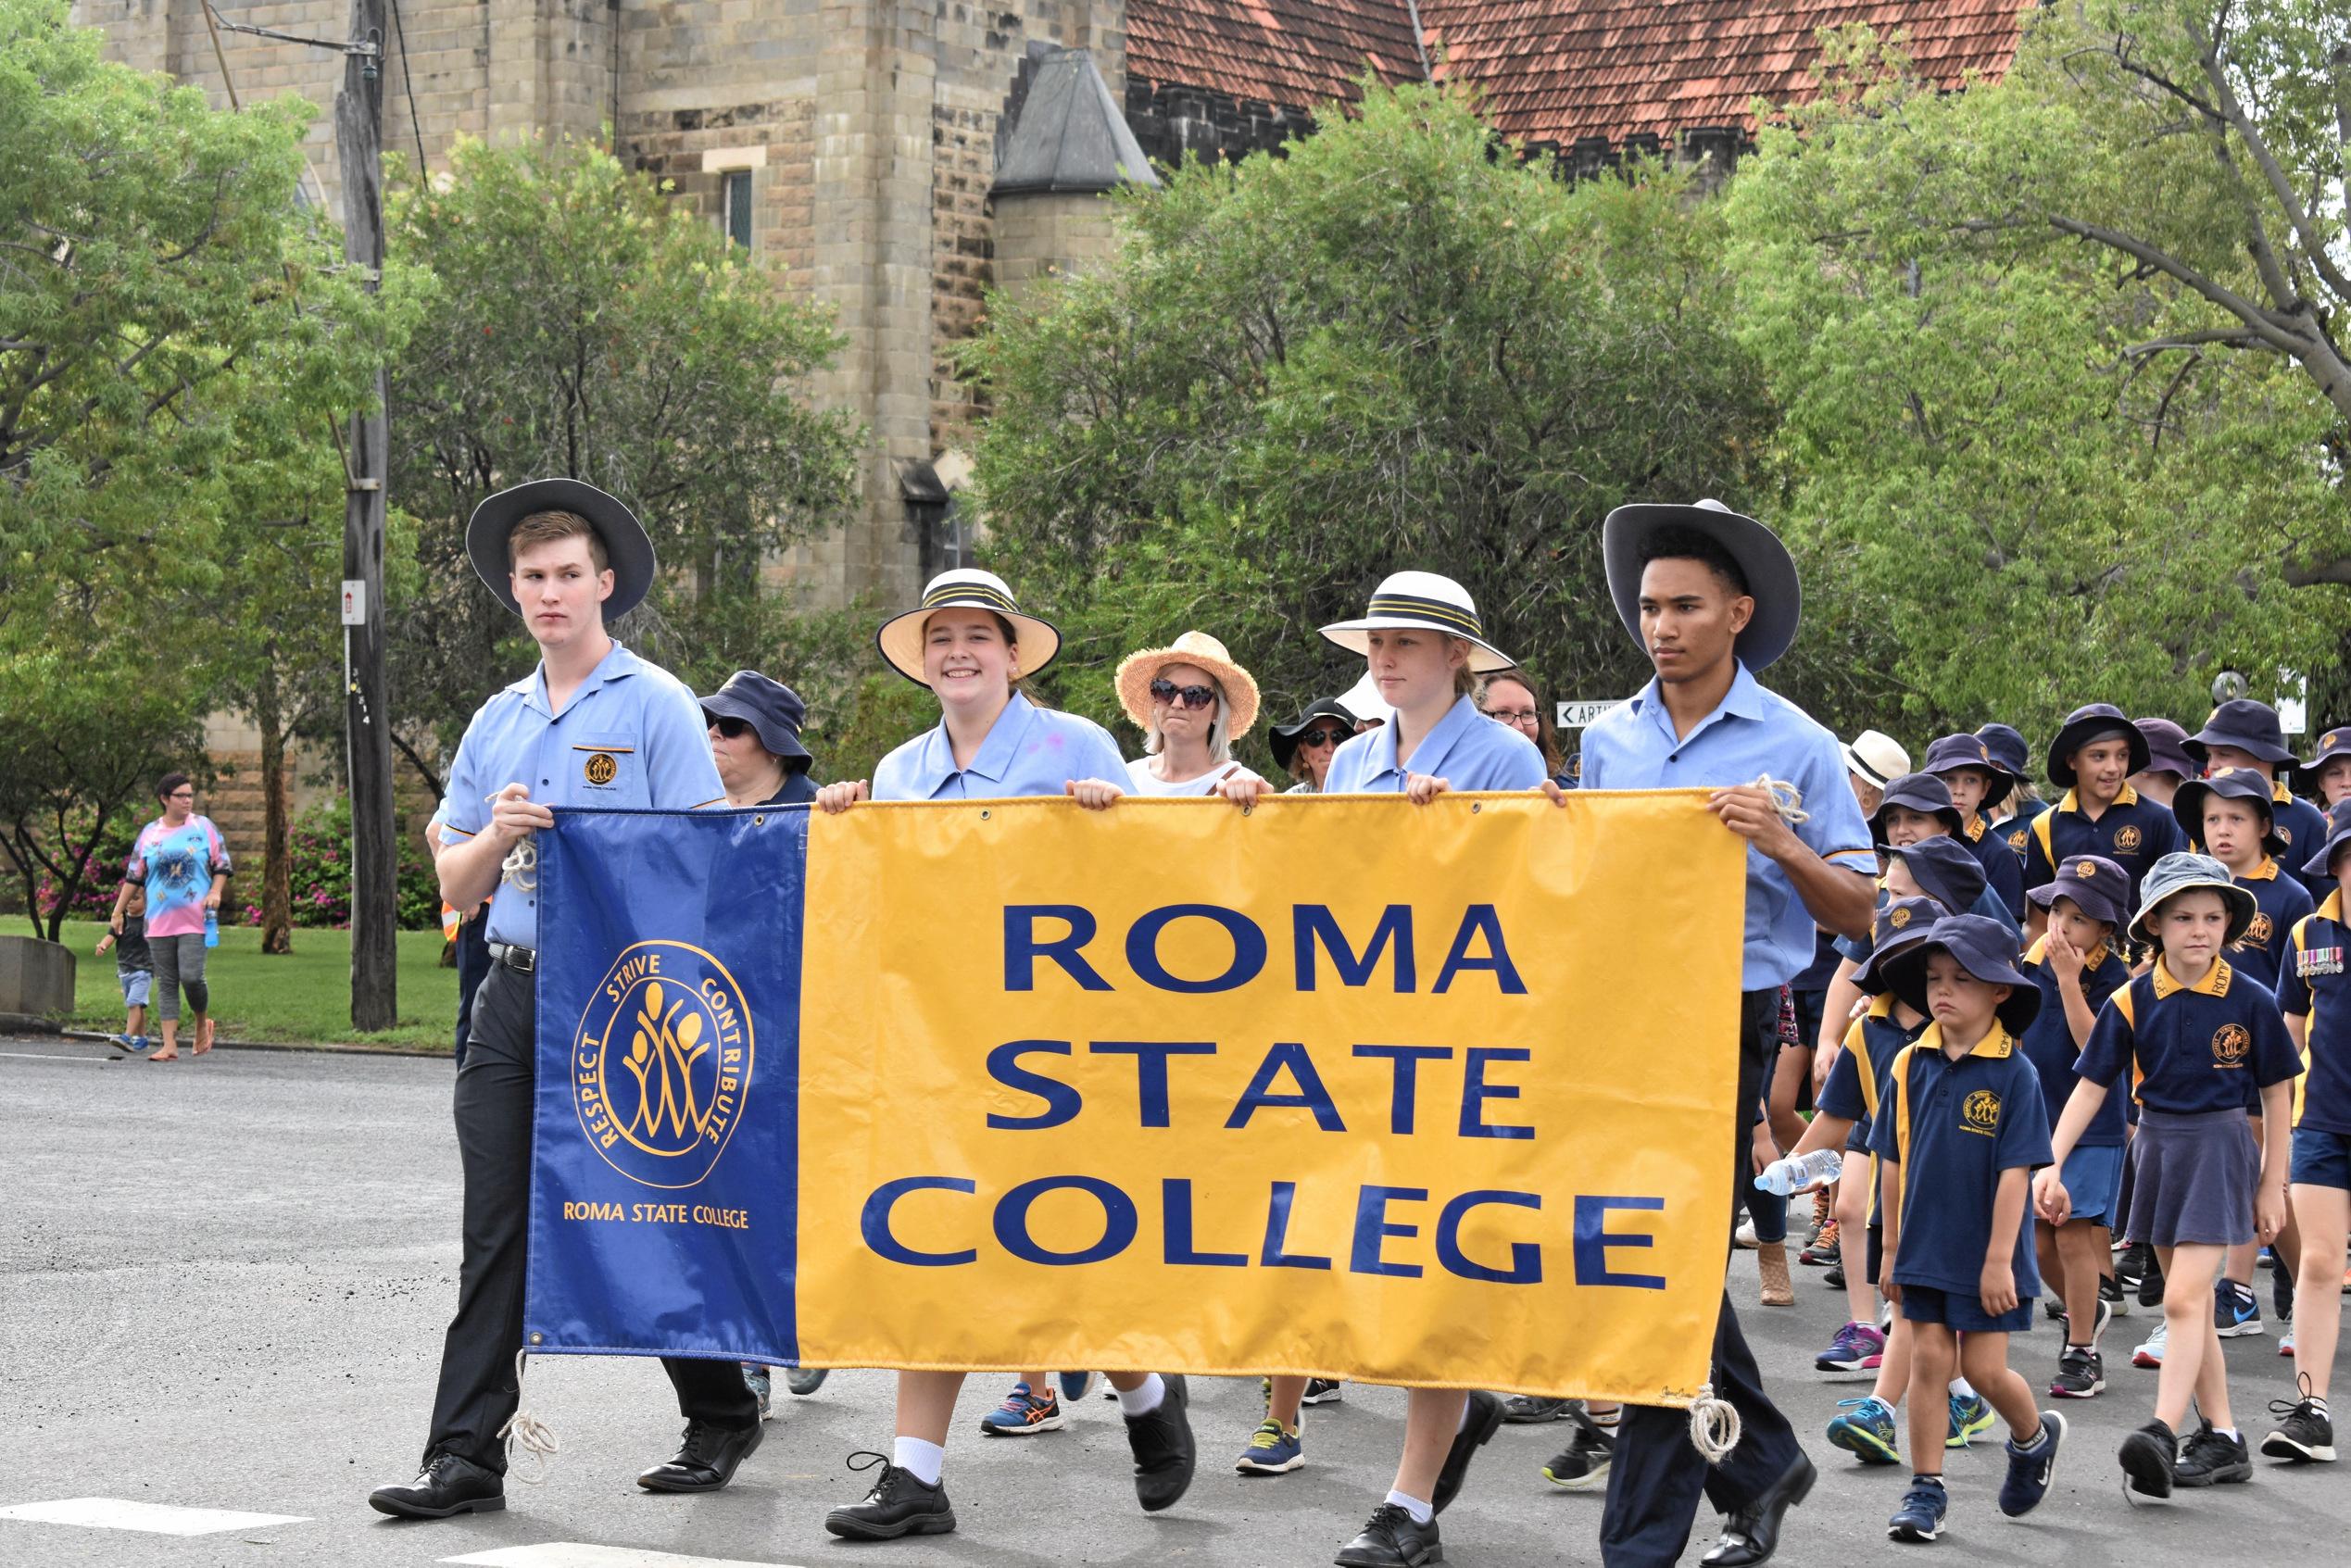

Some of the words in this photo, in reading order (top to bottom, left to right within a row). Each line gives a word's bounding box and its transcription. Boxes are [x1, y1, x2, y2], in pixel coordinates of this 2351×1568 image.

[606, 954, 660, 1003] STRIVE
[1003, 903, 1529, 995] ROMA
[579, 1032, 619, 1149] RESPECT
[701, 977, 742, 1145] CONTRIBUTE
[986, 1039, 1536, 1140] STATE
[563, 1201, 625, 1222] ROMA
[631, 1203, 688, 1223] STATE
[693, 1205, 749, 1229] COLLEGE
[860, 1174, 1666, 1291] COLLEGE
